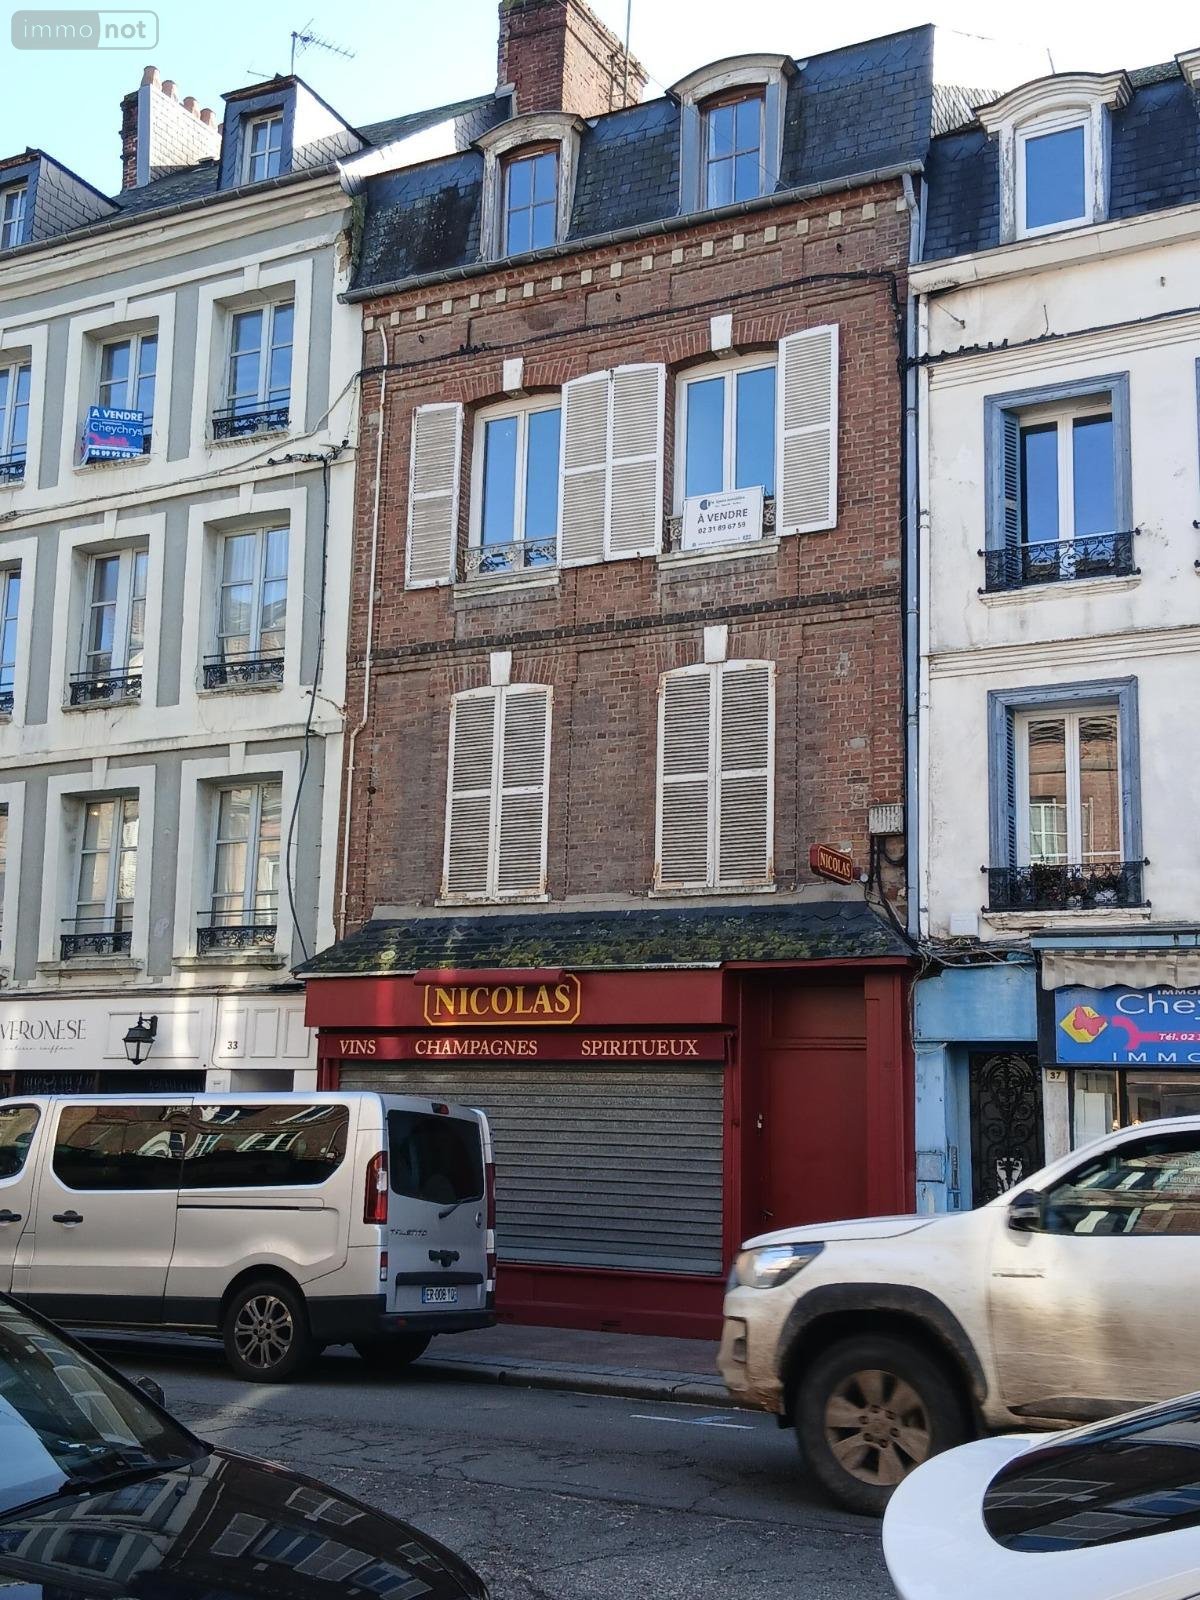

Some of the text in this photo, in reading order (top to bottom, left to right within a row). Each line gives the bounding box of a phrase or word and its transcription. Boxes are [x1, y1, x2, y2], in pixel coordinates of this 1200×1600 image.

[91, 408, 143, 421] A VENDRE
[90, 421, 142, 437] Cheychrys
[707, 508, 749, 522] VENDRE
[820, 852, 851, 878] NICOLAS
[433, 984, 572, 1016] NICOLAS
[1115, 992, 1200, 1020] Che
[0, 1019, 87, 1040] VERONESE
[1180, 1033, 1195, 1041] 02
[227, 1041, 238, 1050] 33
[339, 1038, 700, 1057] VINS CHAMPAGNES SPIRITUEUX
[1050, 1071, 1061, 1080] 37
